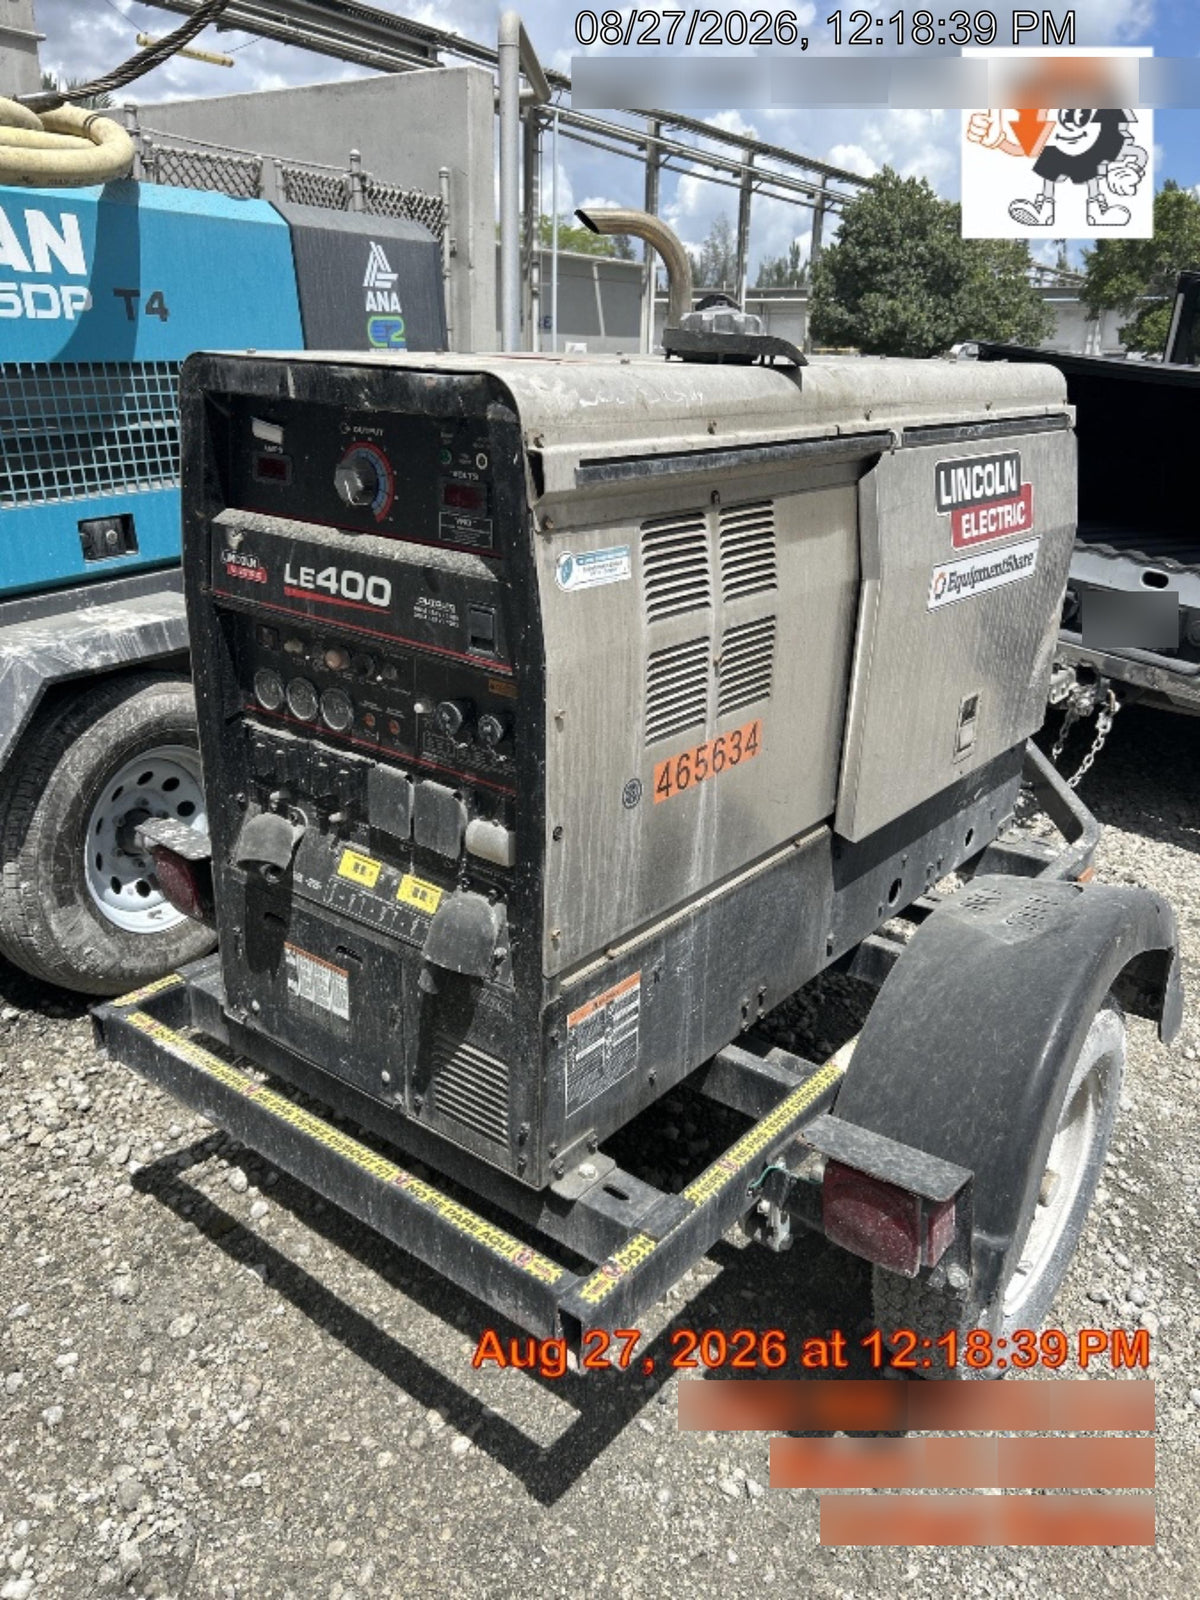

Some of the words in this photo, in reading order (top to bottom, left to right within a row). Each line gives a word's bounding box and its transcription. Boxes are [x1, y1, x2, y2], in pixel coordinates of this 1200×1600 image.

[365, 291, 402, 313] ANA
[940, 460, 1018, 505] LINCOLN
[961, 501, 1025, 539] ELECTRIC
[283, 563, 392, 607] LE400
[947, 552, 1034, 594] EquipmentShare
[656, 721, 758, 796] 465634
[620, 1248, 641, 1267] DO
